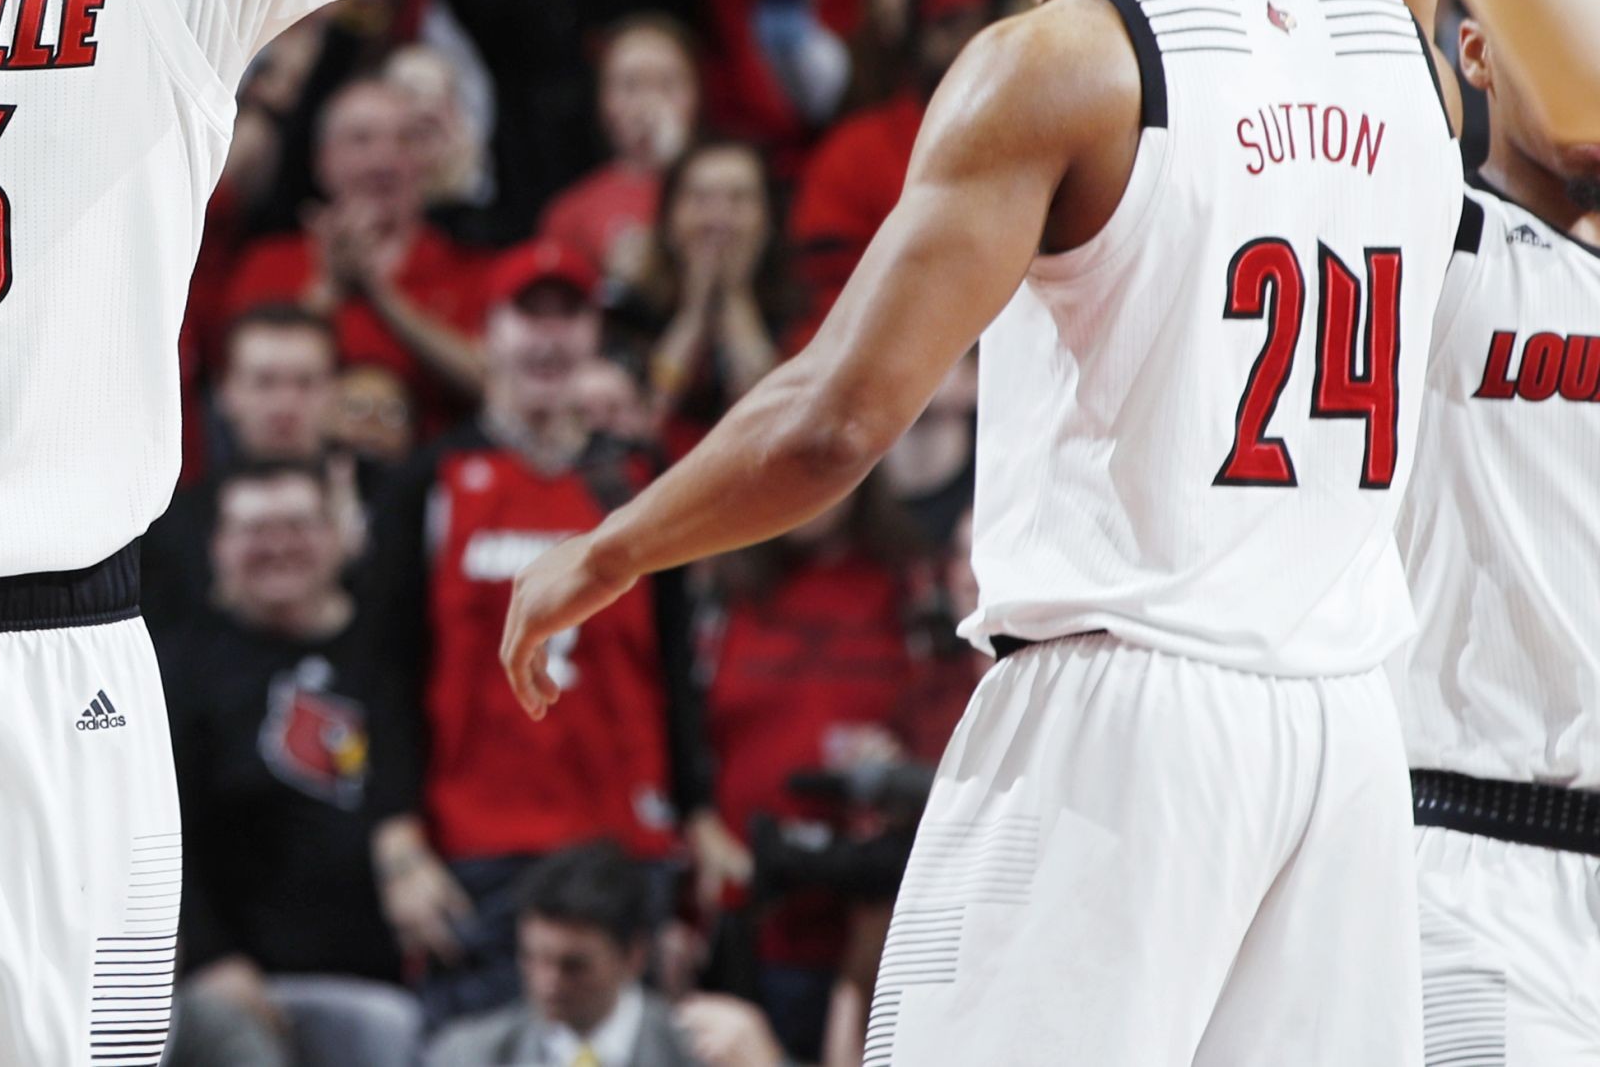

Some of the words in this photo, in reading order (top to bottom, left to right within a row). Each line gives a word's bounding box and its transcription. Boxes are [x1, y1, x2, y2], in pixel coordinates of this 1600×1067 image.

[1236, 103, 1385, 175] SUTTON
[1212, 237, 1401, 489] 24
[1470, 330, 1600, 403] LOU
[75, 714, 127, 731] adidas
